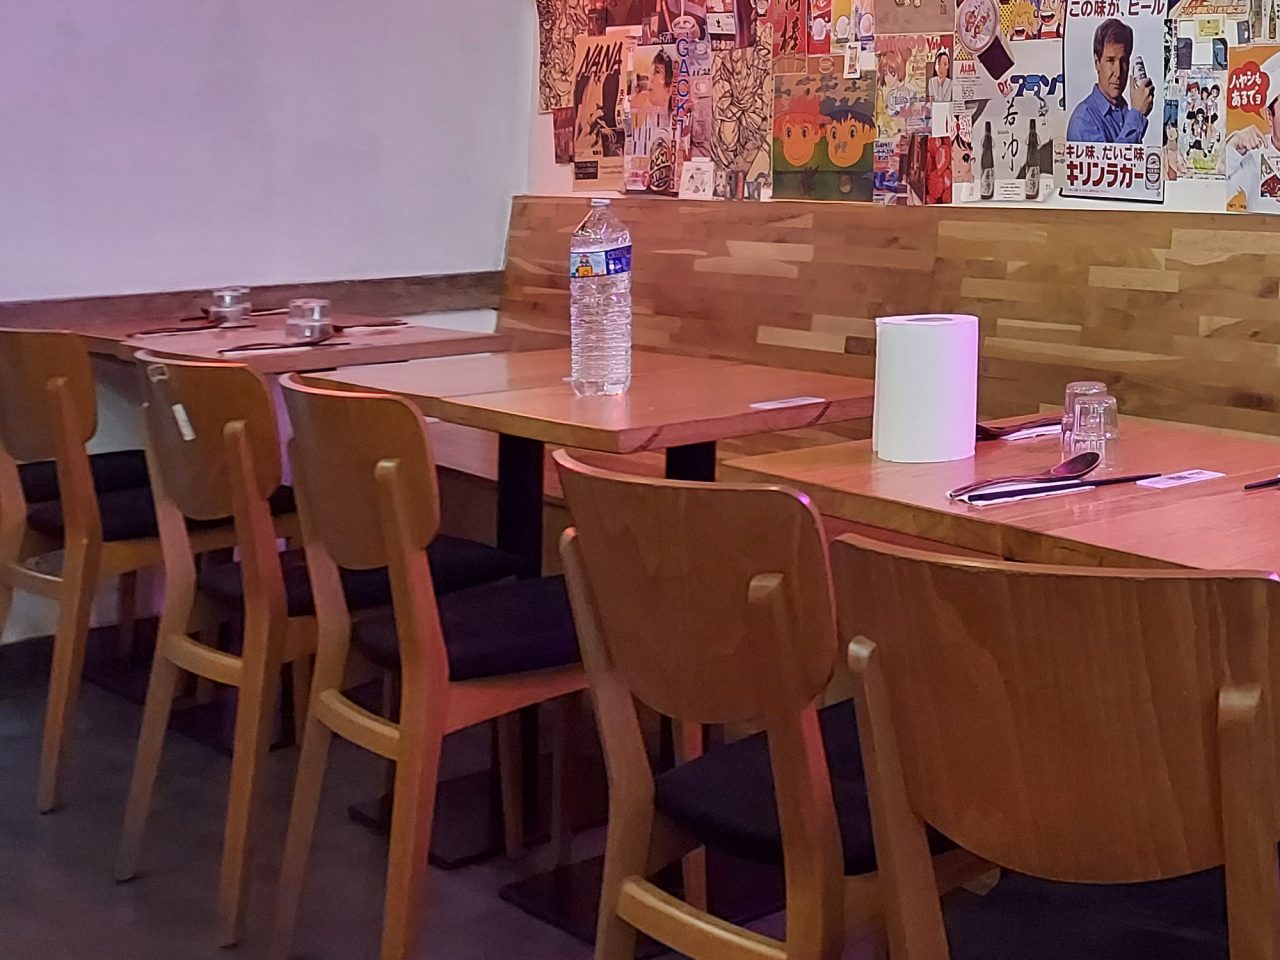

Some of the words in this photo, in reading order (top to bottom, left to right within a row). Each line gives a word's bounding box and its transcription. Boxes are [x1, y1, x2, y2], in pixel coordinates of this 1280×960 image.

[960, 62, 977, 74] ALBA
[1066, 144, 1145, 160] キレ味、だいご味
[1066, 160, 1145, 189] キリンラガー
